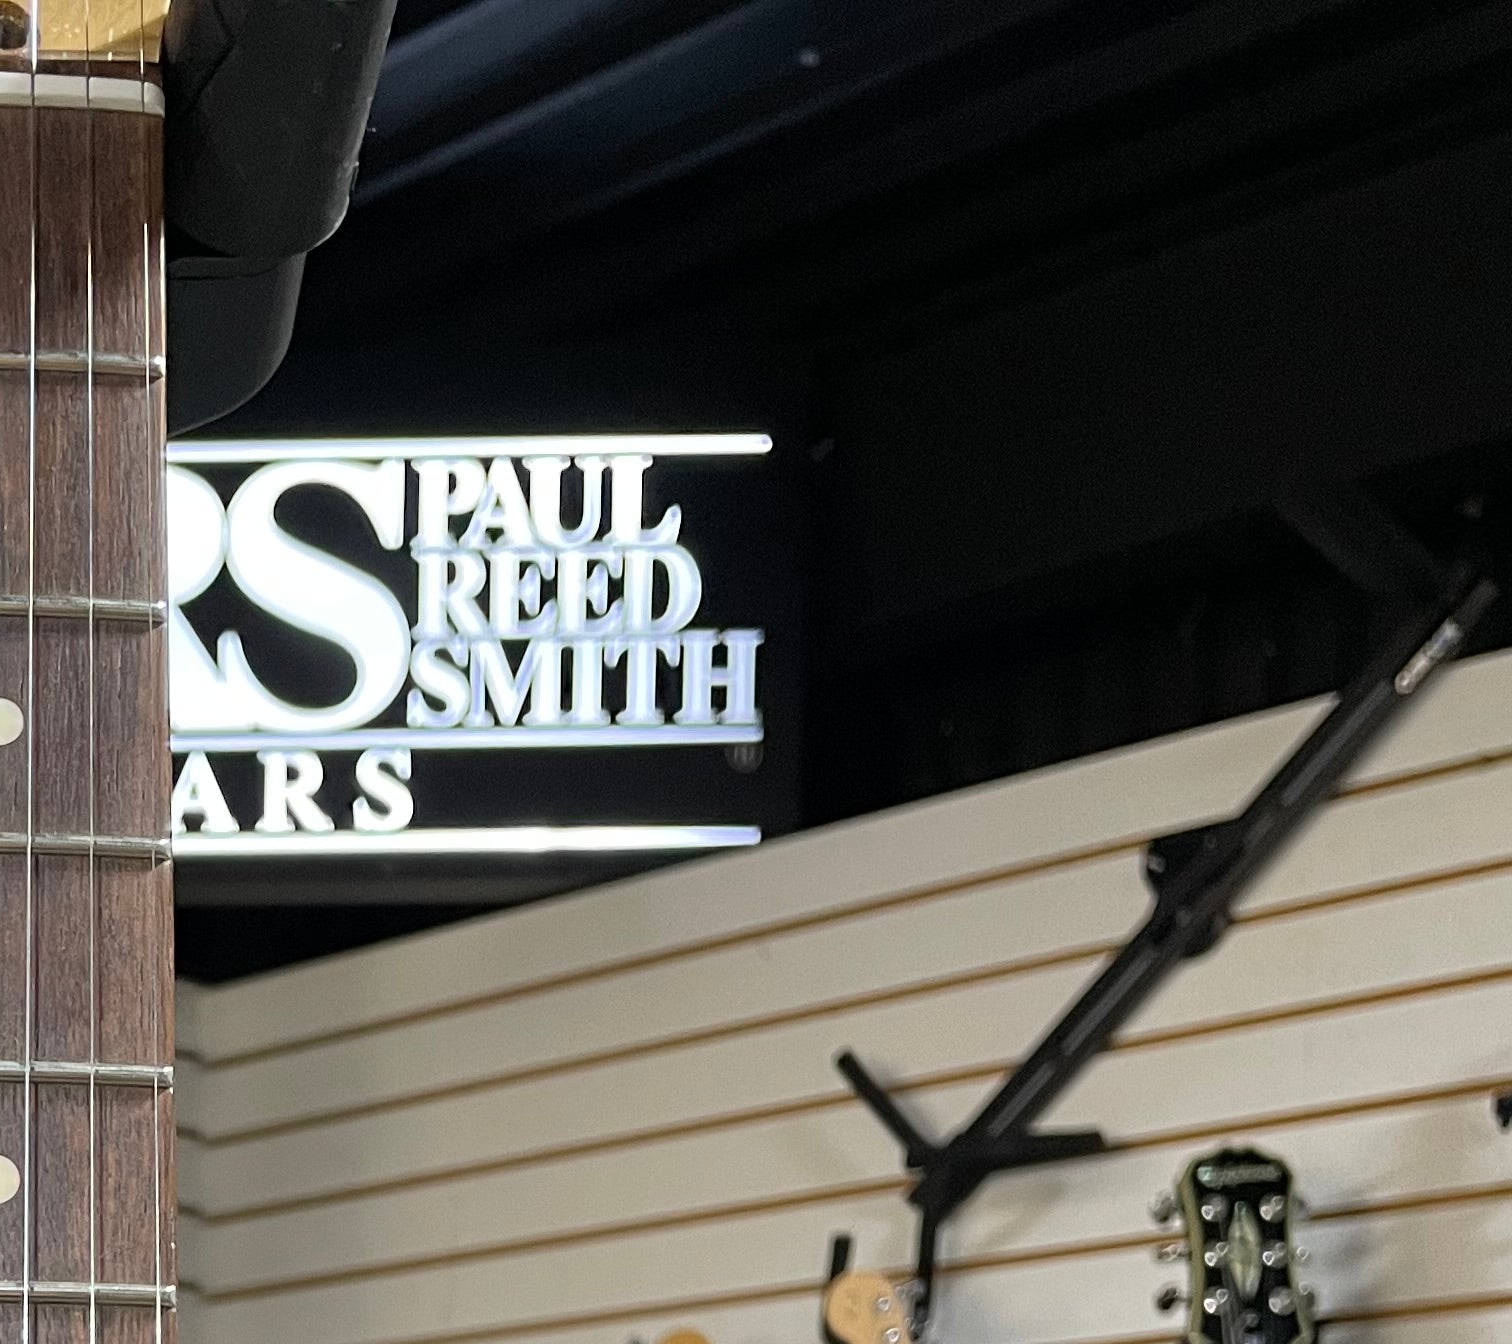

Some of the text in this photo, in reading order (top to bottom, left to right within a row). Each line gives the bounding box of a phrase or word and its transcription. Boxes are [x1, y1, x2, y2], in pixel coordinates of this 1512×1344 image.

[410, 454, 682, 549] PAUL
[411, 546, 702, 641] REED
[406, 630, 765, 728] SMITH
